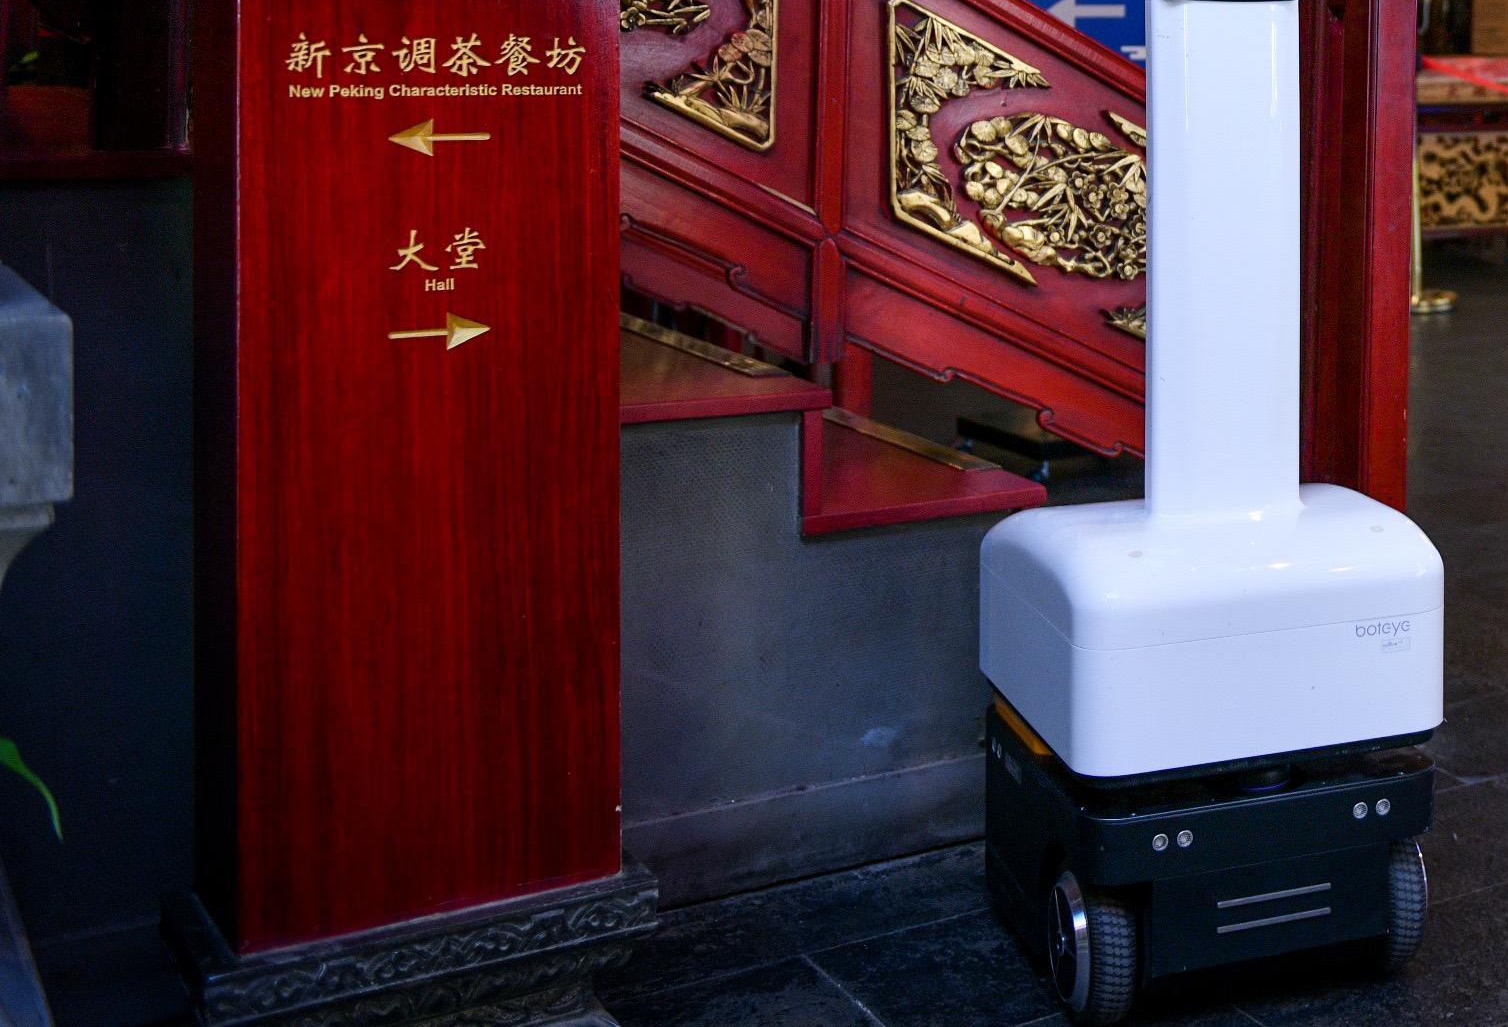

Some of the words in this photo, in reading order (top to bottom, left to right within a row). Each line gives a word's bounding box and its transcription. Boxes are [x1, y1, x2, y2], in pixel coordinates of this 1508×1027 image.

[285, 32, 586, 78] 新京调茶餐坊
[289, 85, 325, 98] New
[329, 84, 385, 100] Peking
[389, 83, 497, 97] Characteristic
[501, 83, 582, 97] Restaurant
[388, 227, 486, 271] 大堂
[424, 277, 455, 292] Hall
[1355, 620, 1411, 638] boteye
